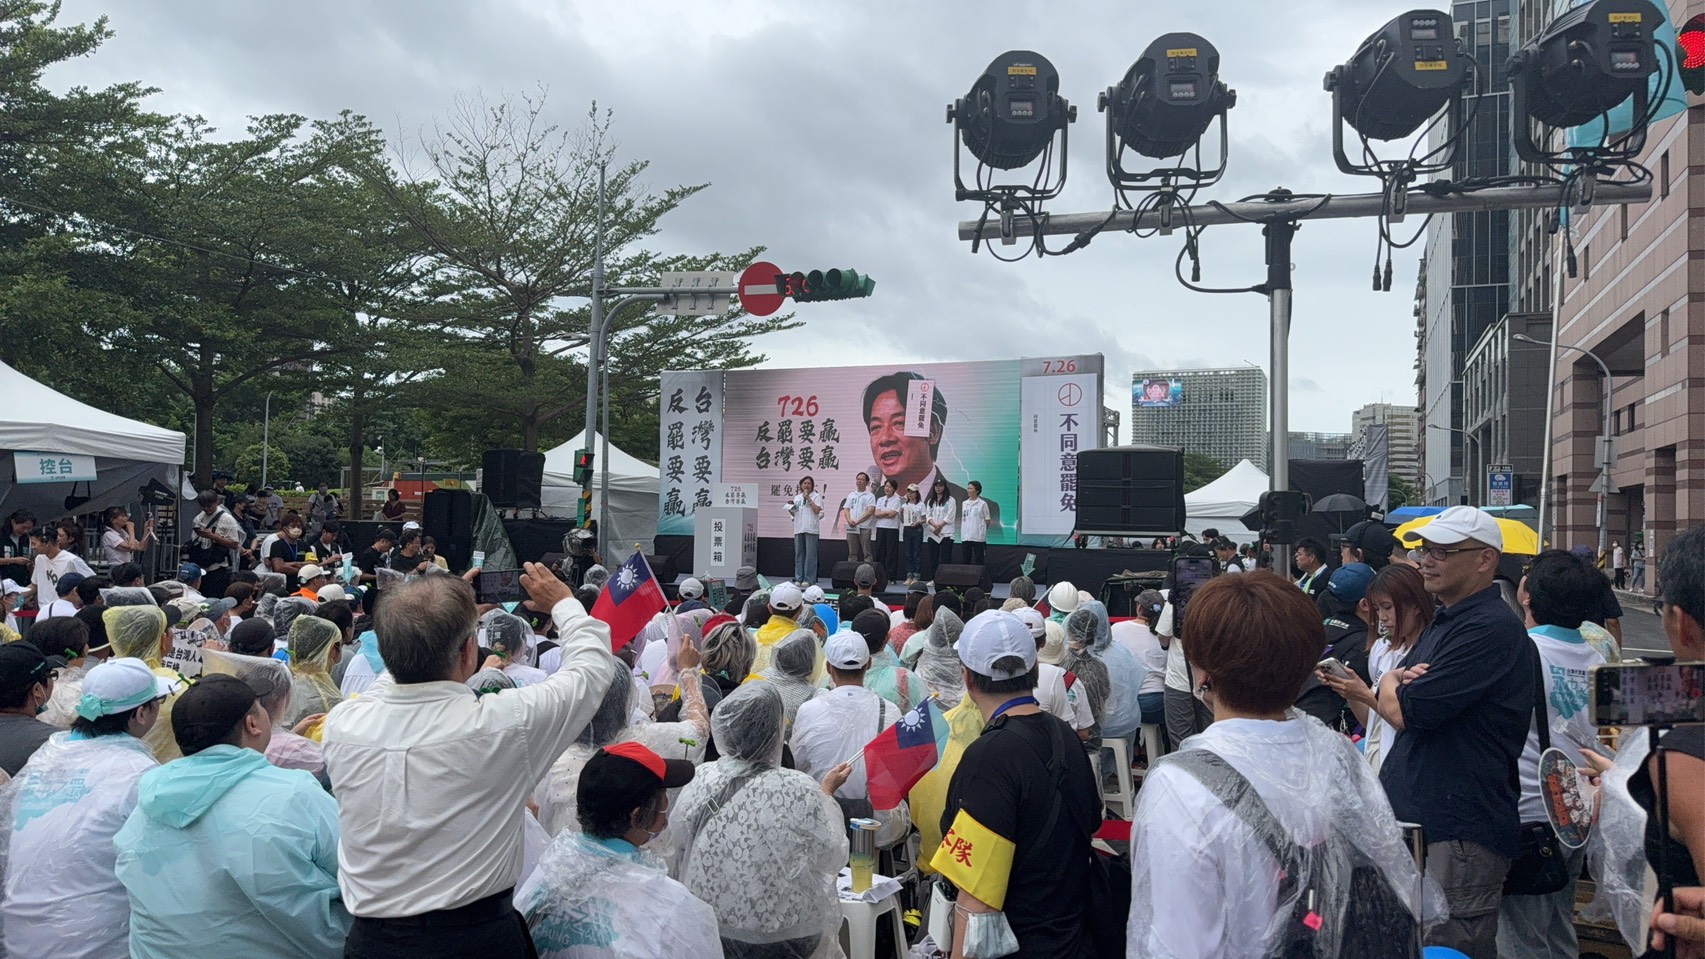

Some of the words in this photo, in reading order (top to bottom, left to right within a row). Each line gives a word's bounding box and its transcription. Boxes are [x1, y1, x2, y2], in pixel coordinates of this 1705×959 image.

[1043, 360, 1076, 374] 7.26
[777, 395, 819, 418] 726
[754, 418, 840, 445] 反罷要贏
[664, 388, 689, 517] 反罷要贏
[755, 445, 839, 471] 台灣要贏
[1059, 413, 1078, 513] 不同意罷免
[40, 458, 72, 475] 控台
[713, 521, 723, 562] 投票箱
